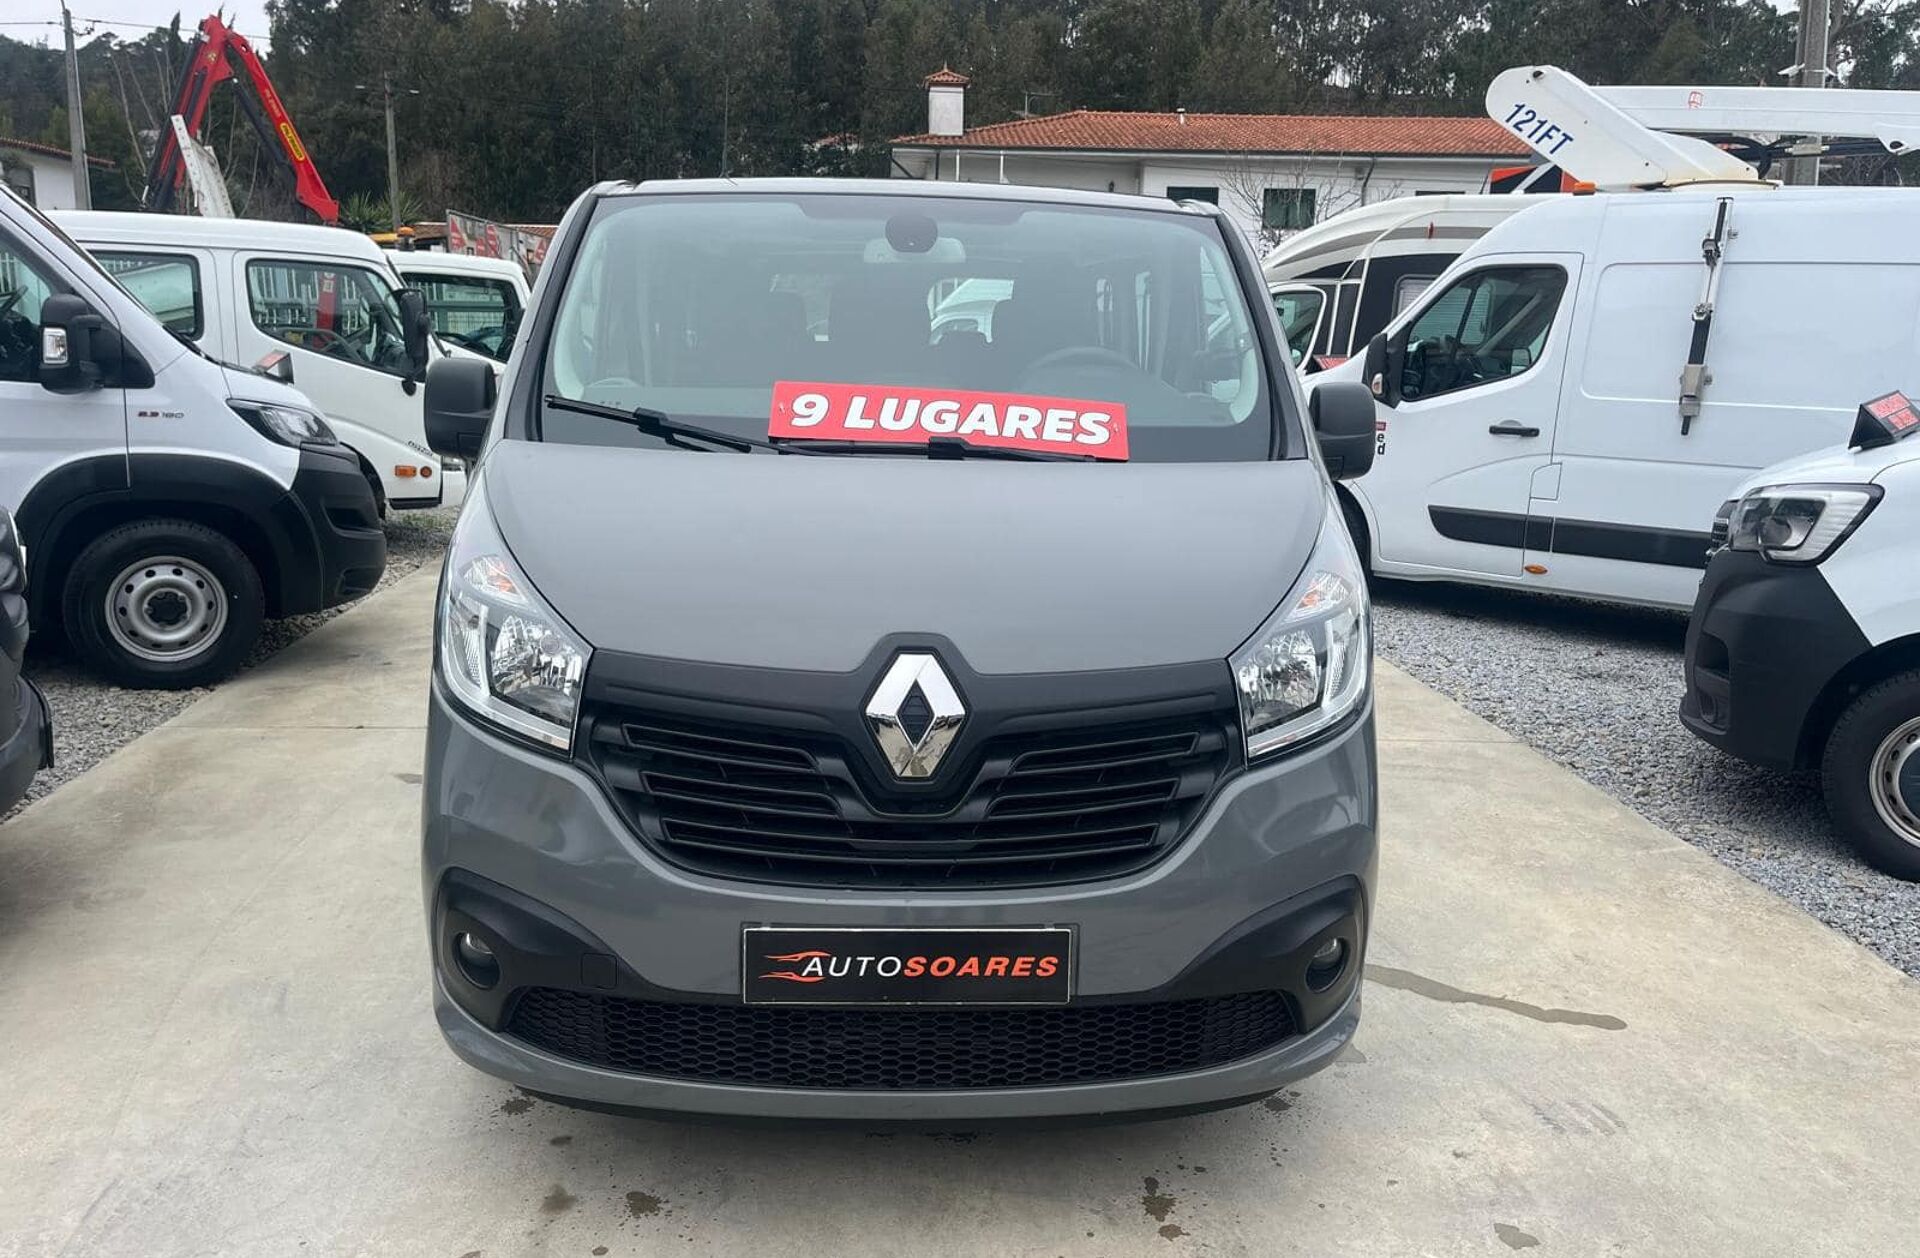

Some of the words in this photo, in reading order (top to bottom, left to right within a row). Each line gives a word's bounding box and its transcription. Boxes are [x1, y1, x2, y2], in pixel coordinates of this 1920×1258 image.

[1505, 104, 1574, 155] 121FT
[790, 393, 829, 427] 9
[843, 395, 1112, 445] LUGARES
[802, 956, 1059, 977] AUTOSOARES
